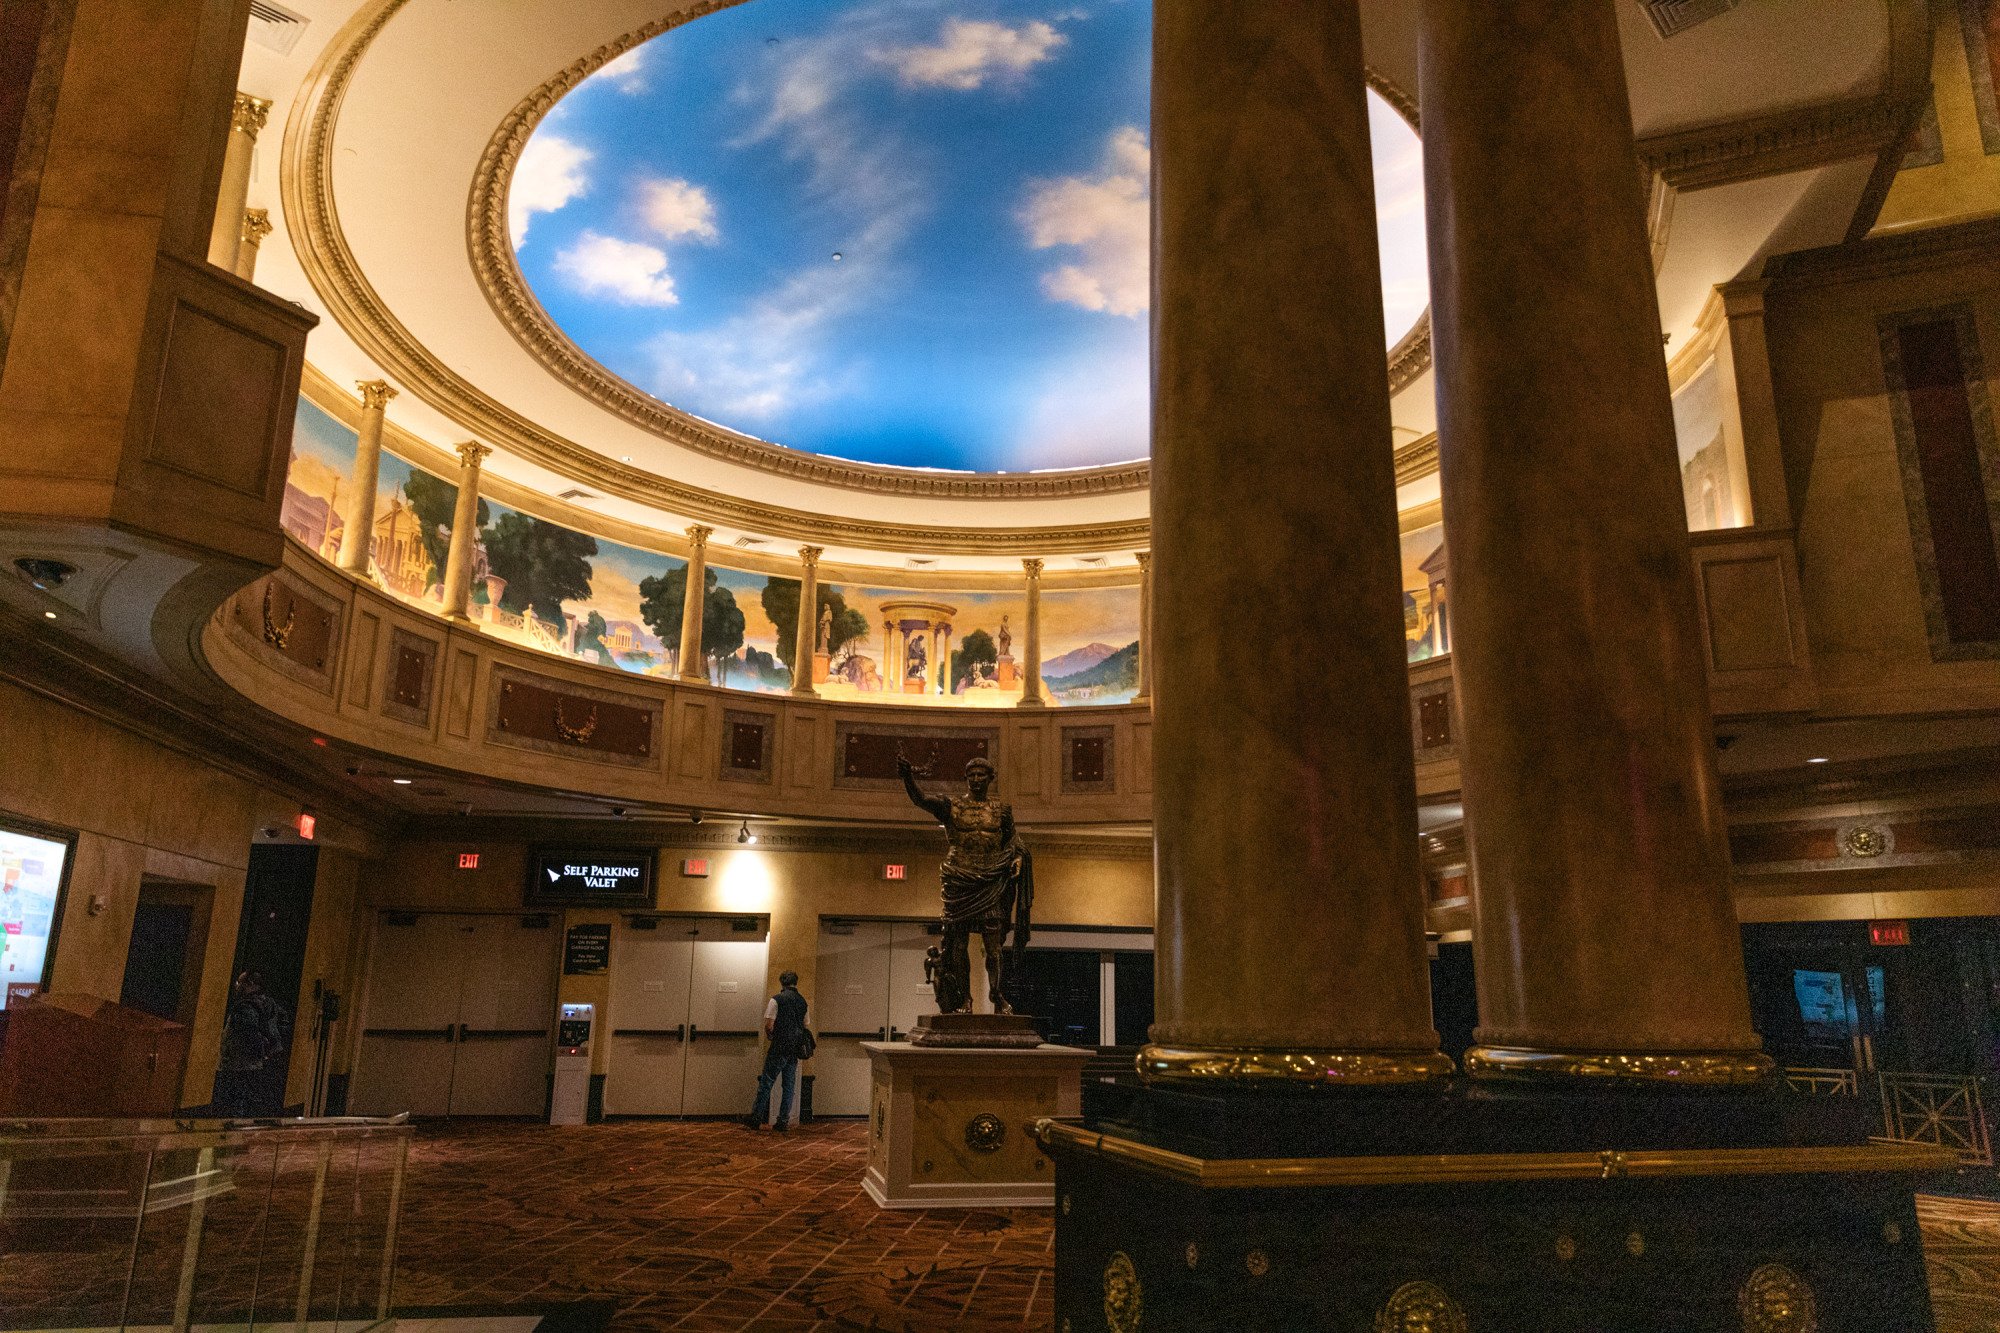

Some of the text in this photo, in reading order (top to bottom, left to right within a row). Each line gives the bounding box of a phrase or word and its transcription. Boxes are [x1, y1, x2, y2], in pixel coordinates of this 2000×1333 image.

[460, 853, 480, 869] EXIT
[688, 859, 706, 874] EXIT
[563, 864, 639, 877] SELF PARKING
[886, 865, 904, 878] EXIT
[584, 877, 617, 888] VALET
